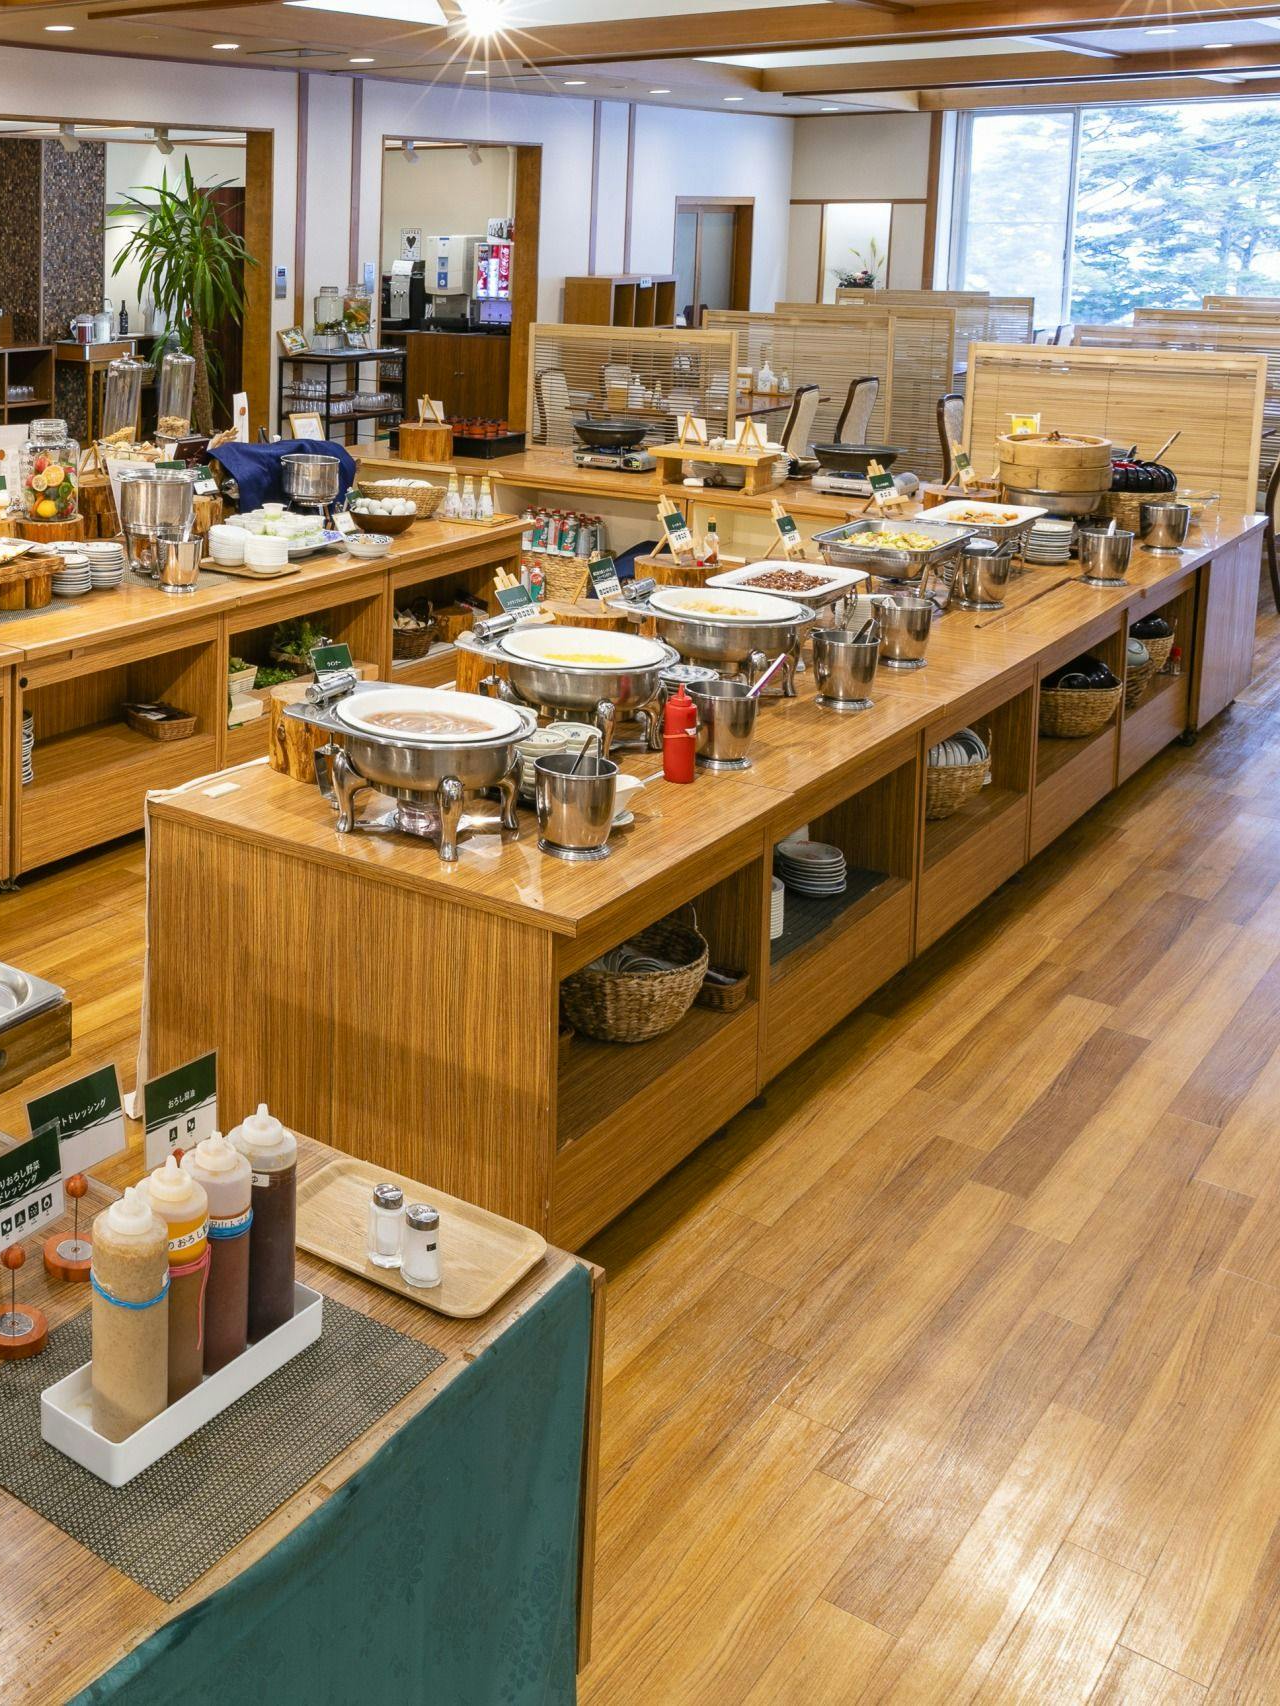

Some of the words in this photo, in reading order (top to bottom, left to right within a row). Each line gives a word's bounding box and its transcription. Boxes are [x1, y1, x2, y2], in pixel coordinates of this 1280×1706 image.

[58, 1096, 107, 1128] トドレッシング
[168, 1089, 197, 1110] おろし醤油
